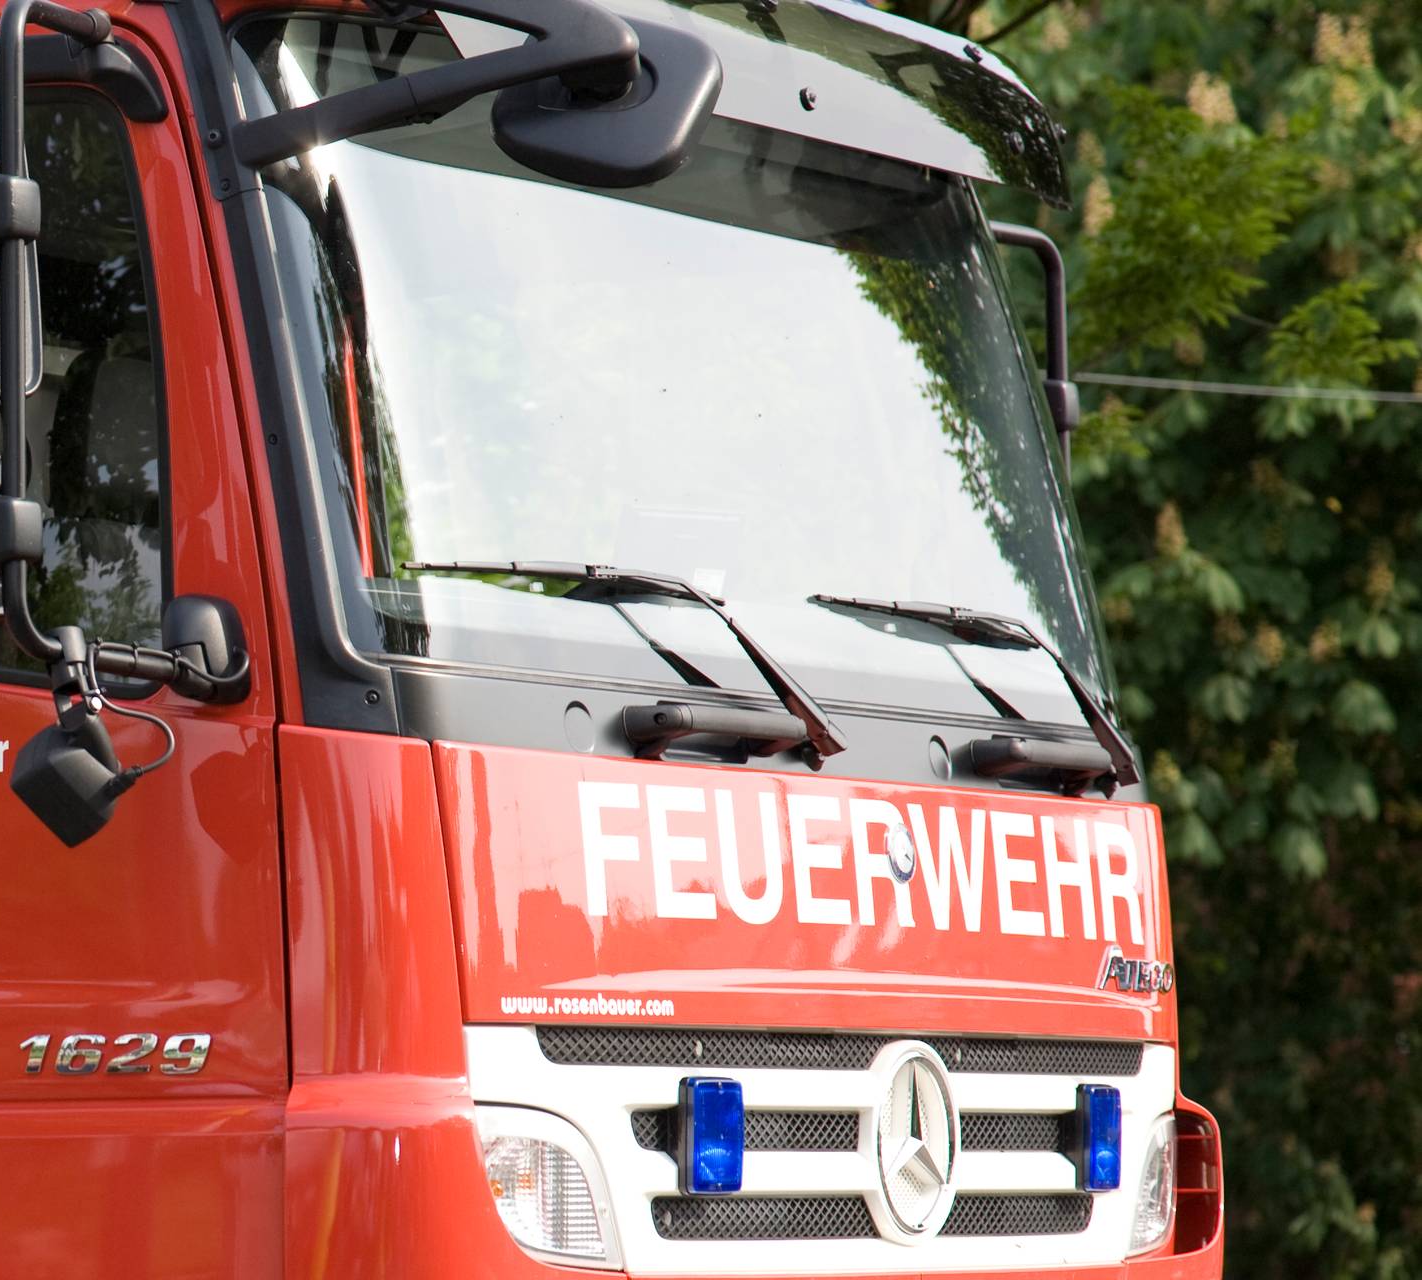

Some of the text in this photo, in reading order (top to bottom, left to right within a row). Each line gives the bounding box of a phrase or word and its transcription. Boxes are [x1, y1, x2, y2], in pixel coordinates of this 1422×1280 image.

[577, 781, 1145, 946] FEUERWEHR
[500, 993, 675, 1016] www.rosenbauer.com
[18, 1032, 213, 1076] 1629
